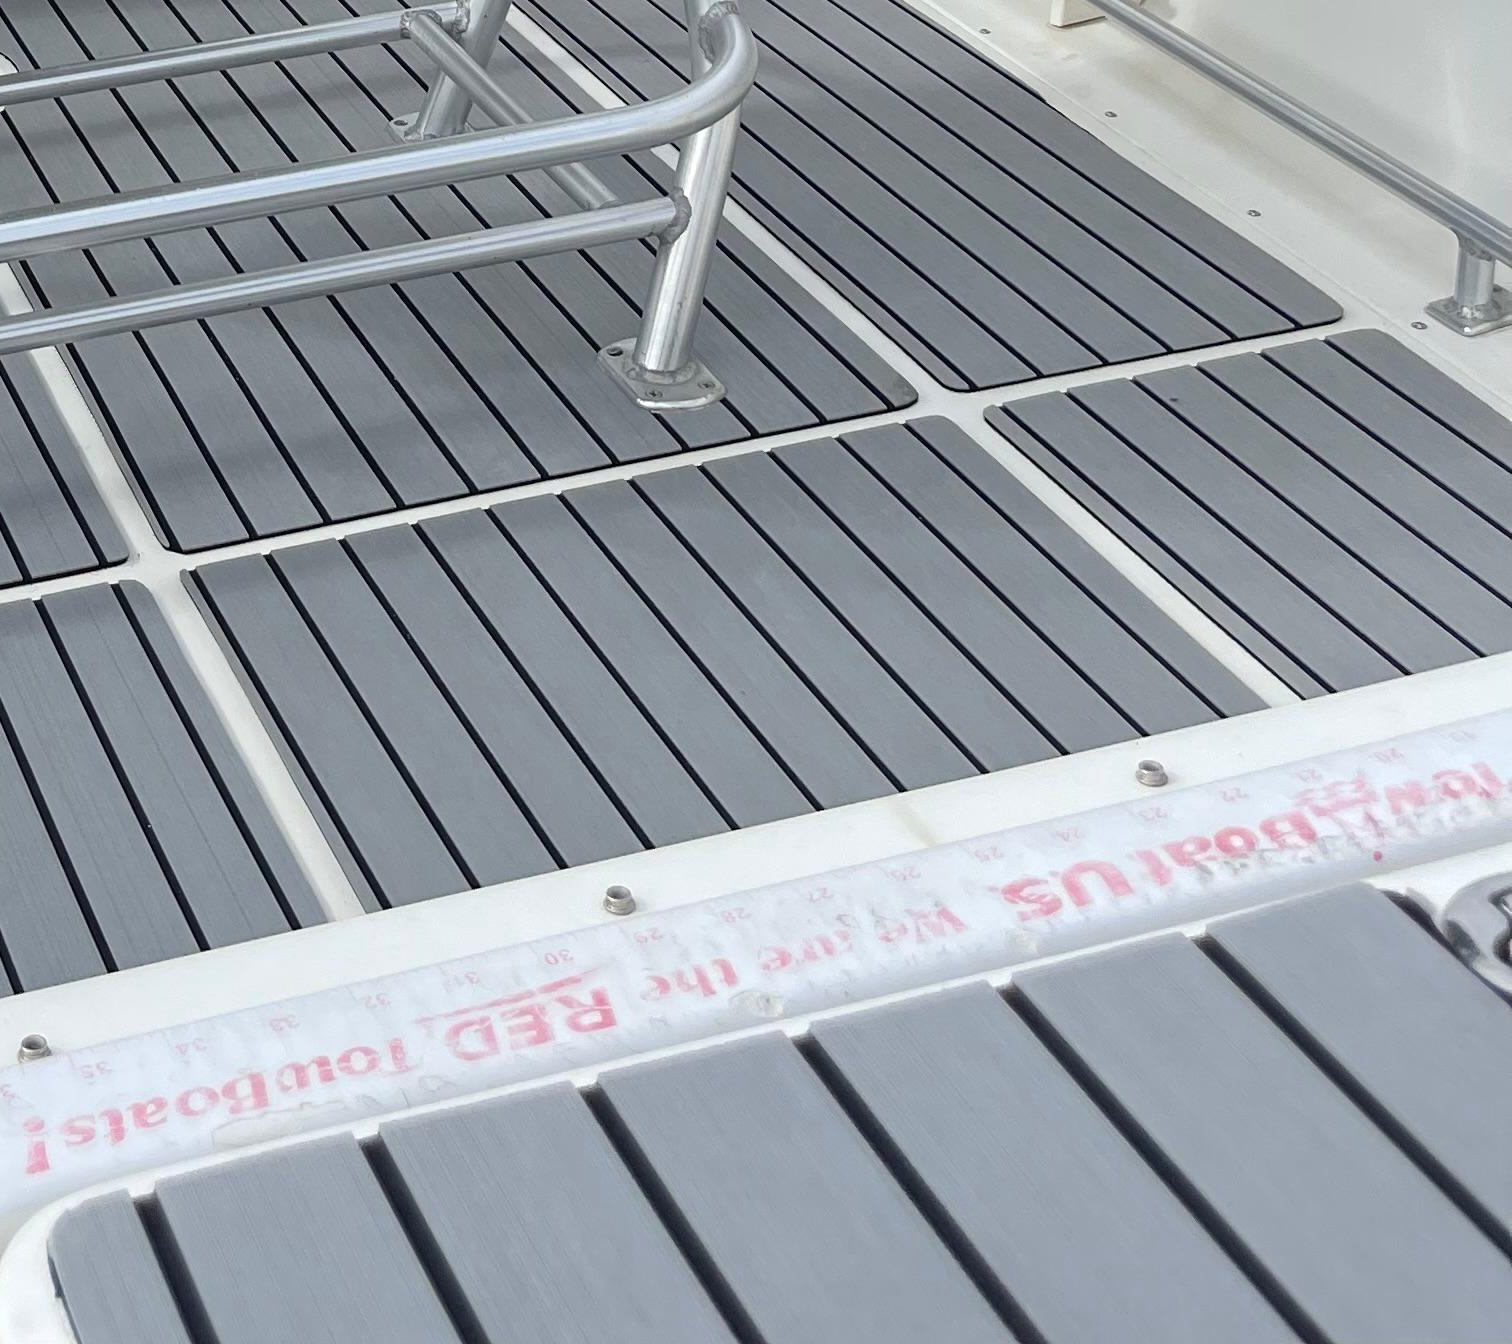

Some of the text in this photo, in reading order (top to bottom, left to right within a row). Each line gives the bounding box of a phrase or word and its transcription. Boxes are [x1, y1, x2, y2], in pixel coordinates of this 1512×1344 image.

[542, 945, 573, 967] 30
[641, 956, 741, 1008] the
[444, 986, 618, 1062] RED
